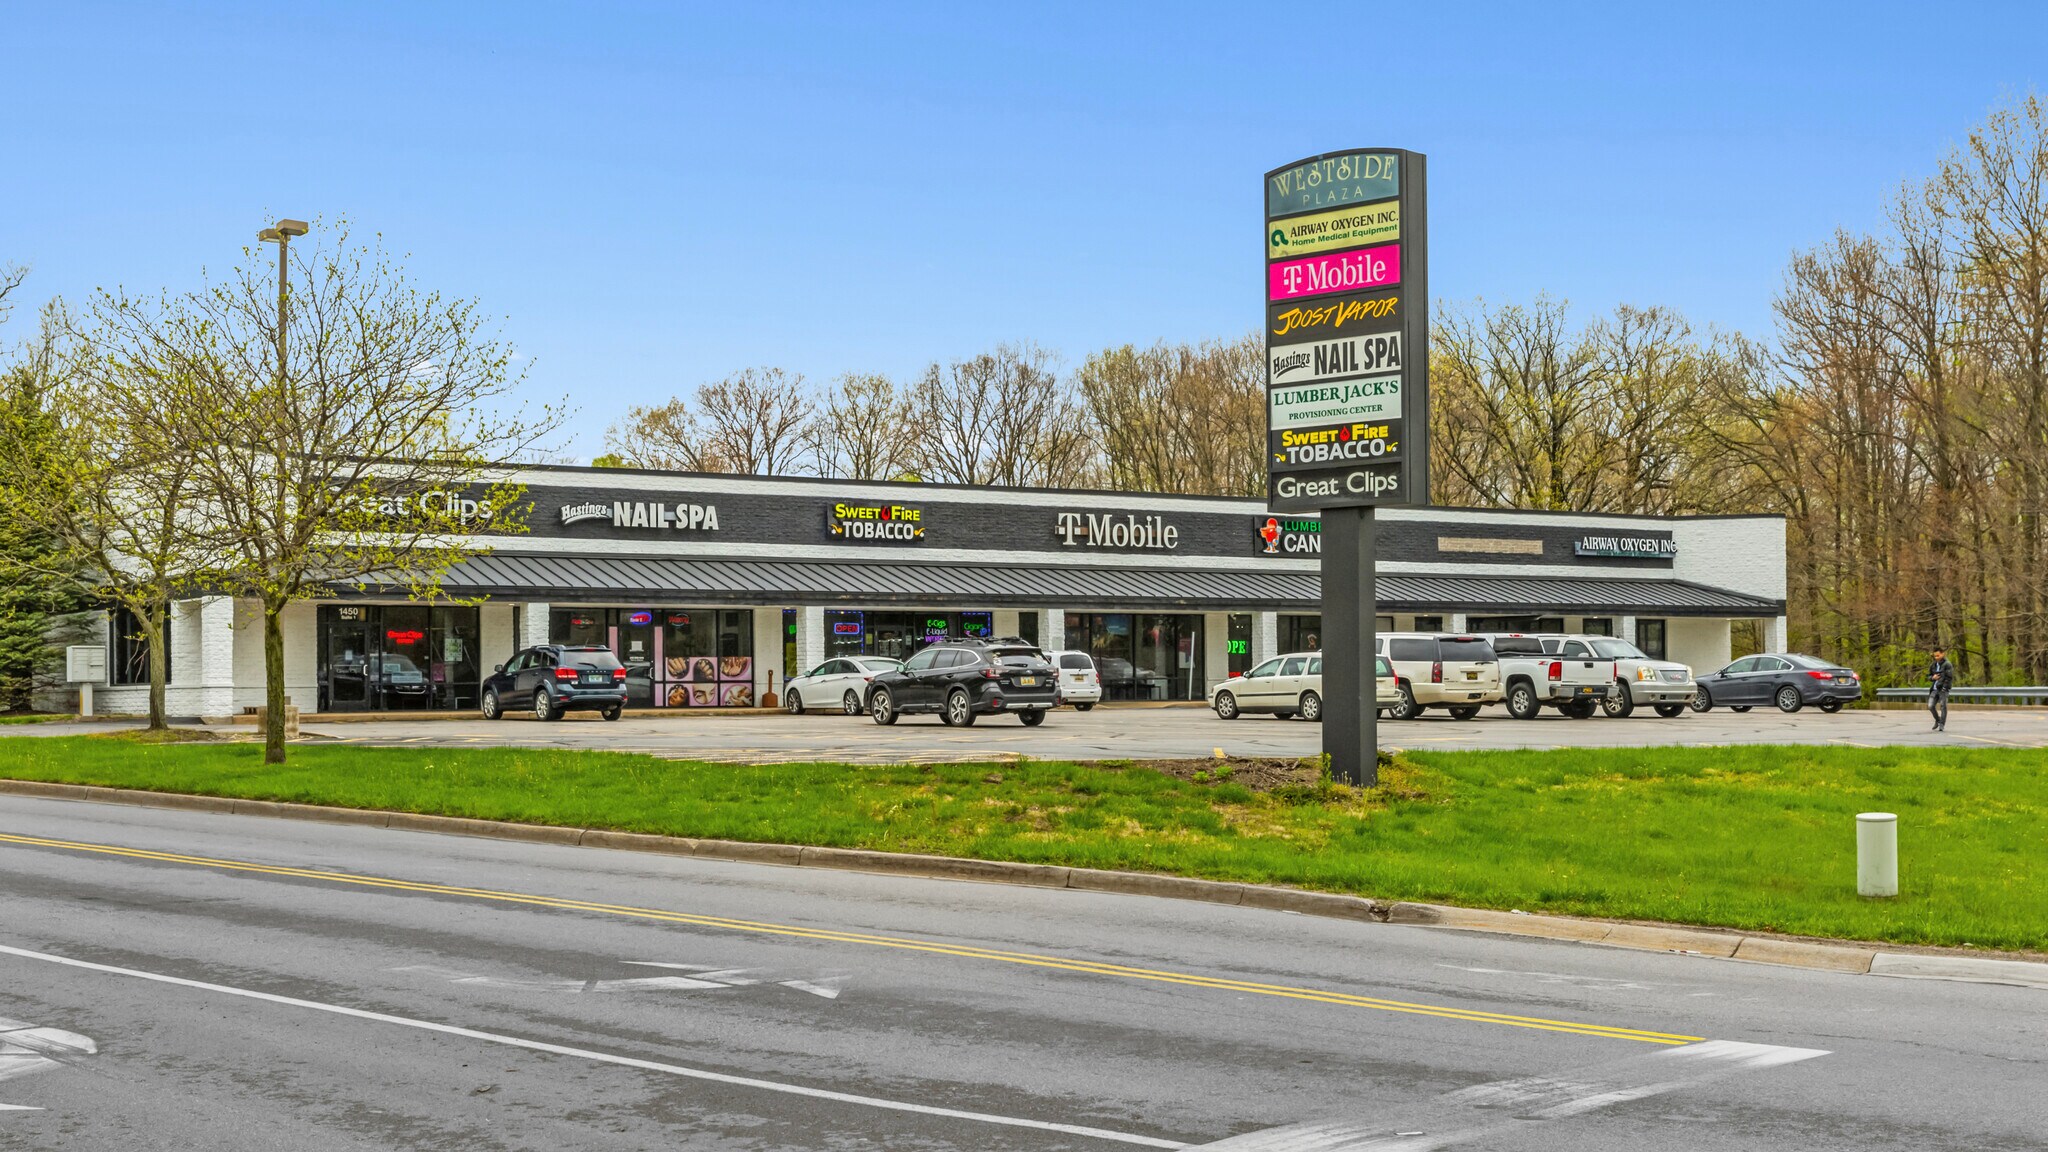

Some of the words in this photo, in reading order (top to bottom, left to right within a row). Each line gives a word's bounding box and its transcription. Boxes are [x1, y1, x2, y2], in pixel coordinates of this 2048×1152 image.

[1273, 155, 1395, 198] WESTSIDE
[1303, 185, 1363, 206] PLAZA
[1290, 221, 1329, 238] AIRWAY
[1331, 213, 1375, 231] OXYGEN
[1377, 210, 1399, 224] INC.
[1292, 237, 1316, 247] Home
[1318, 231, 1350, 242] Medical
[1352, 224, 1398, 238] Equipment
[1273, 351, 1311, 377] Hastings
[1314, 341, 1359, 376] NAIL
[1364, 335, 1401, 371] SPA
[1288, 407, 1349, 421] PROVISIONING
[1349, 404, 1383, 415] CENTER
[1282, 429, 1338, 447] SWEET
[1286, 438, 1386, 464] TOBACCO
[1277, 477, 1339, 498] Great
[1346, 471, 1398, 498] Clips
[561, 502, 607, 521] Hastings
[613, 501, 669, 529] NAIL
[675, 503, 719, 531] SPA
[835, 503, 881, 519] SWEET
[842, 521, 914, 540] TOBACCO
[1582, 536, 1618, 550] AIRWAY
[1620, 538, 1659, 552] OXYGEN
[339, 607, 358, 615] 1450
